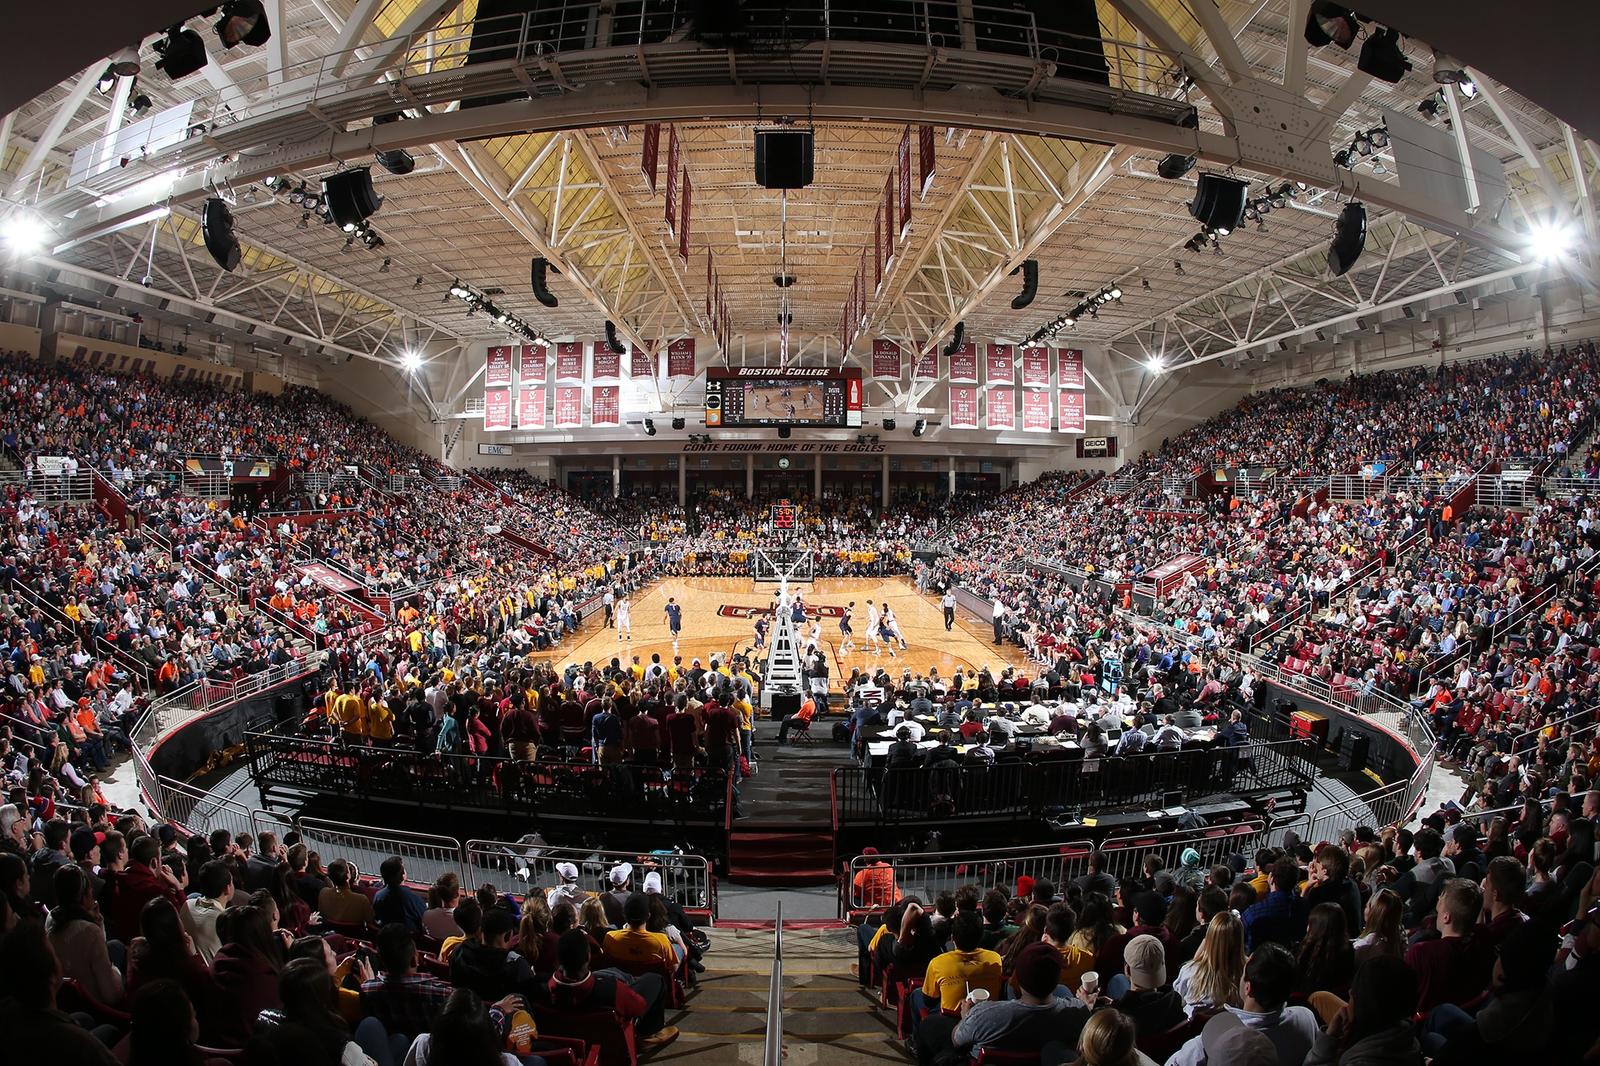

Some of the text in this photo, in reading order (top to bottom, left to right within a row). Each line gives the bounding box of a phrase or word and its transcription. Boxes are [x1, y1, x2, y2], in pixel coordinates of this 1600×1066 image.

[684, 443, 886, 452] CONTE FORUM HOME OF THE EAGLES
